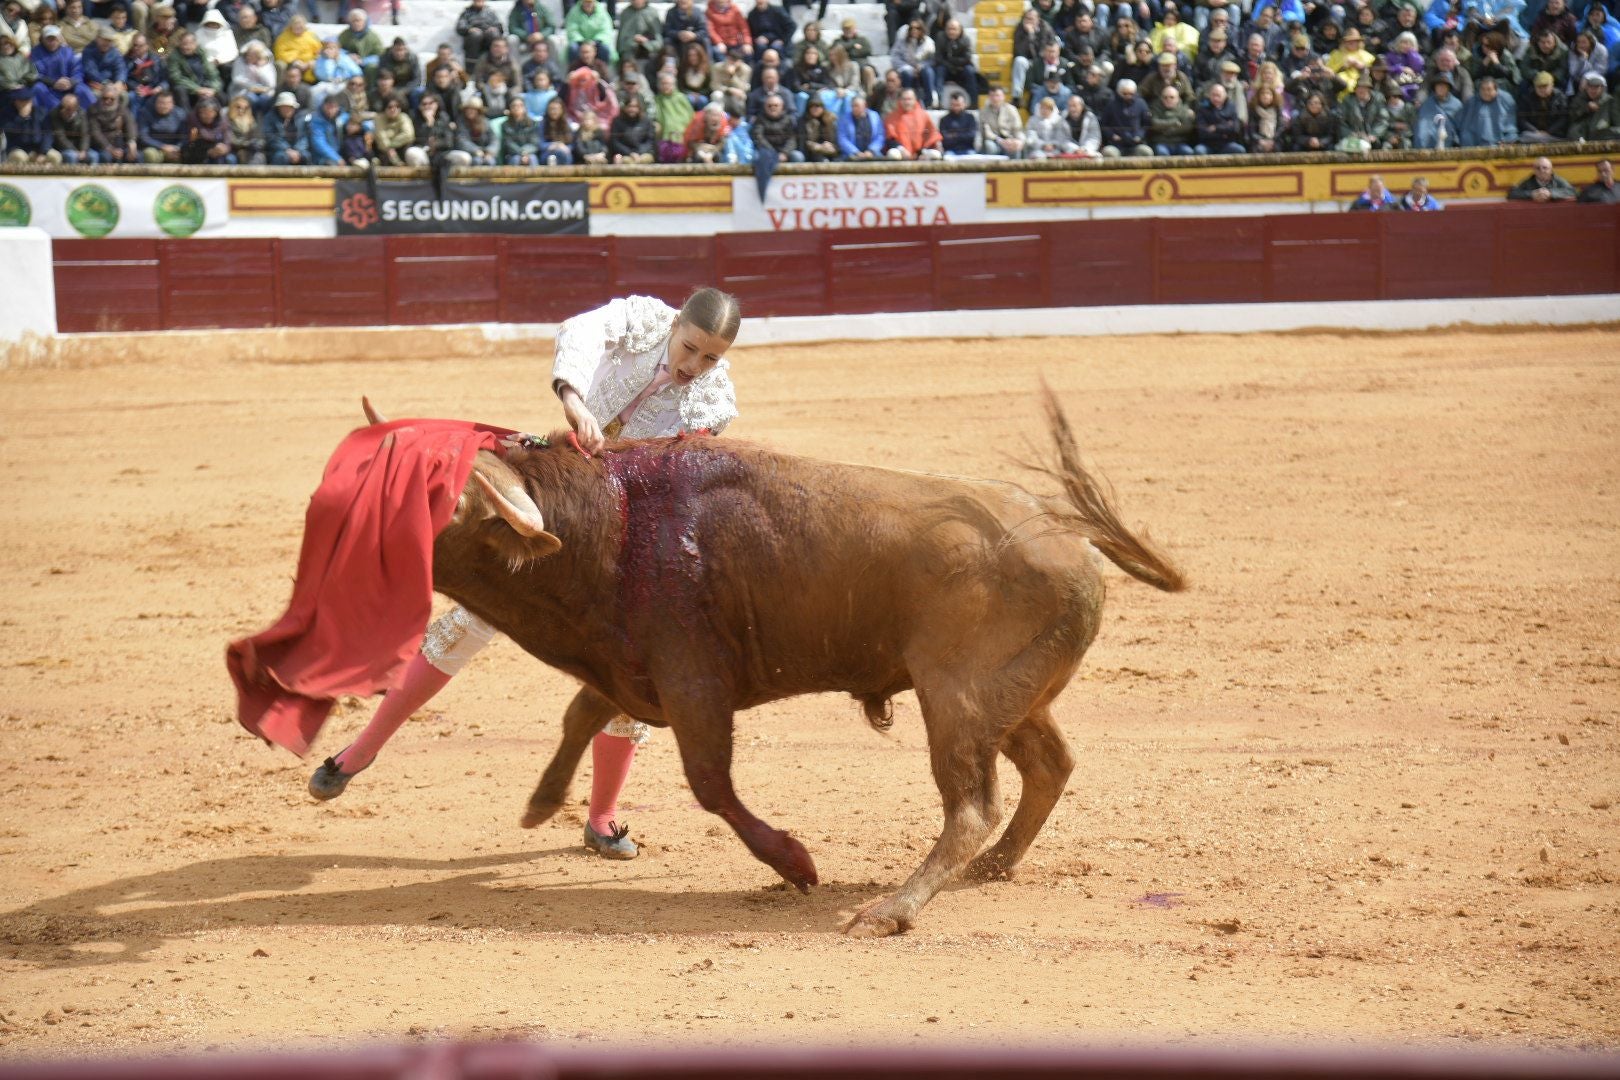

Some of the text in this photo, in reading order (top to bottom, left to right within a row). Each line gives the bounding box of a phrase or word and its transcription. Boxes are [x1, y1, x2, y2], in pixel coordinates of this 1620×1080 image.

[781, 180, 940, 200] CERVEZAS
[381, 195, 584, 221] SEGUNDÍN.COM
[767, 205, 952, 231] VICTORIA
